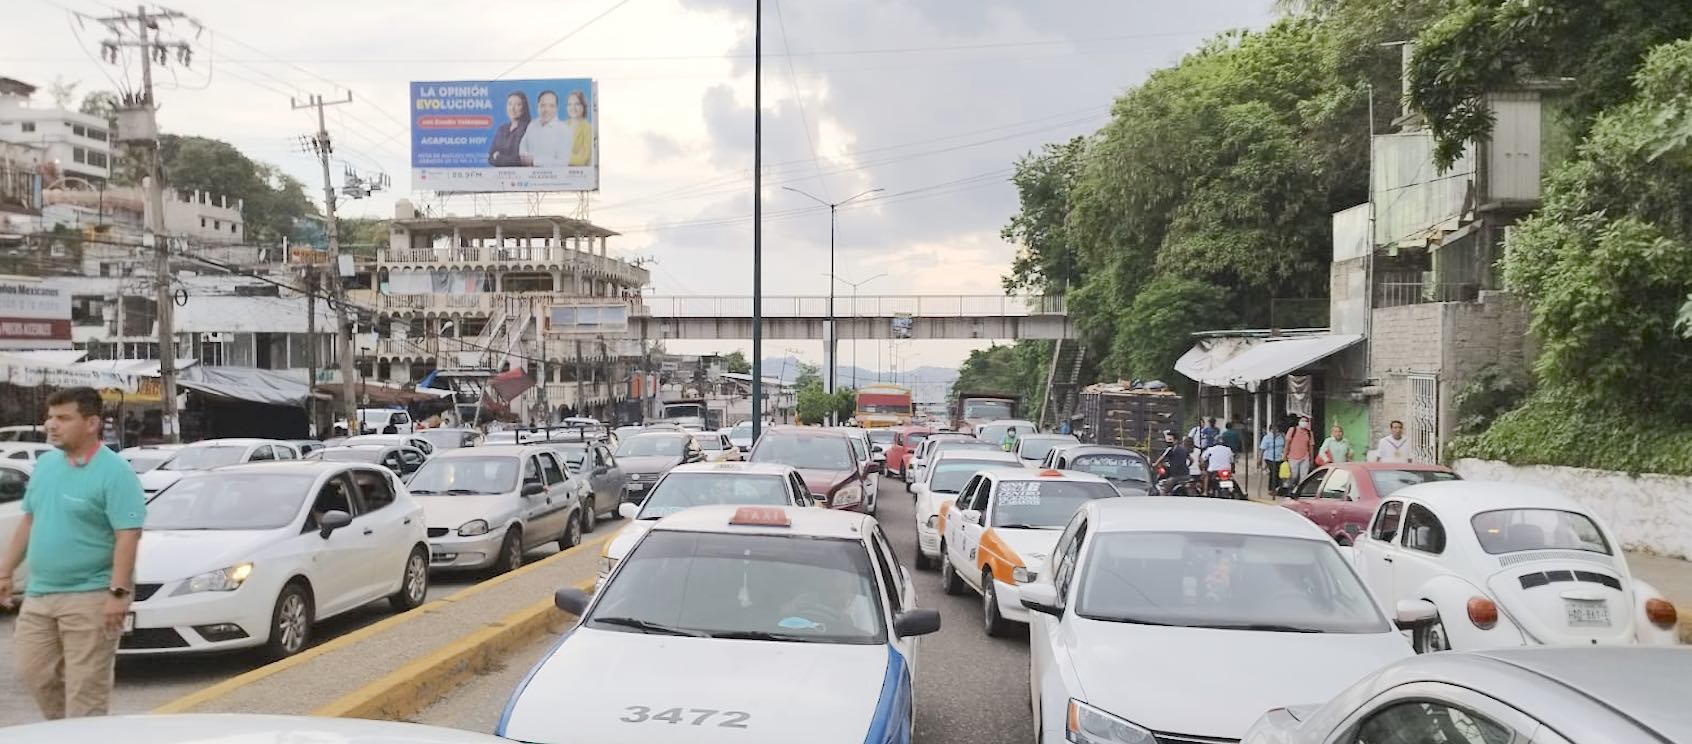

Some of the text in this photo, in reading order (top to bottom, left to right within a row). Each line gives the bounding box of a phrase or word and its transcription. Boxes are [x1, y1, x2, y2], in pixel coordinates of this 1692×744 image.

[420, 84, 489, 97] LA OPINIÓN
[416, 98, 493, 110] EVOLUCIONA
[421, 136, 488, 145] ACAPULCO HOY
[19, 284, 59, 297] Mexicanos
[741, 509, 778, 521] TAXI
[619, 705, 751, 729] 3472
